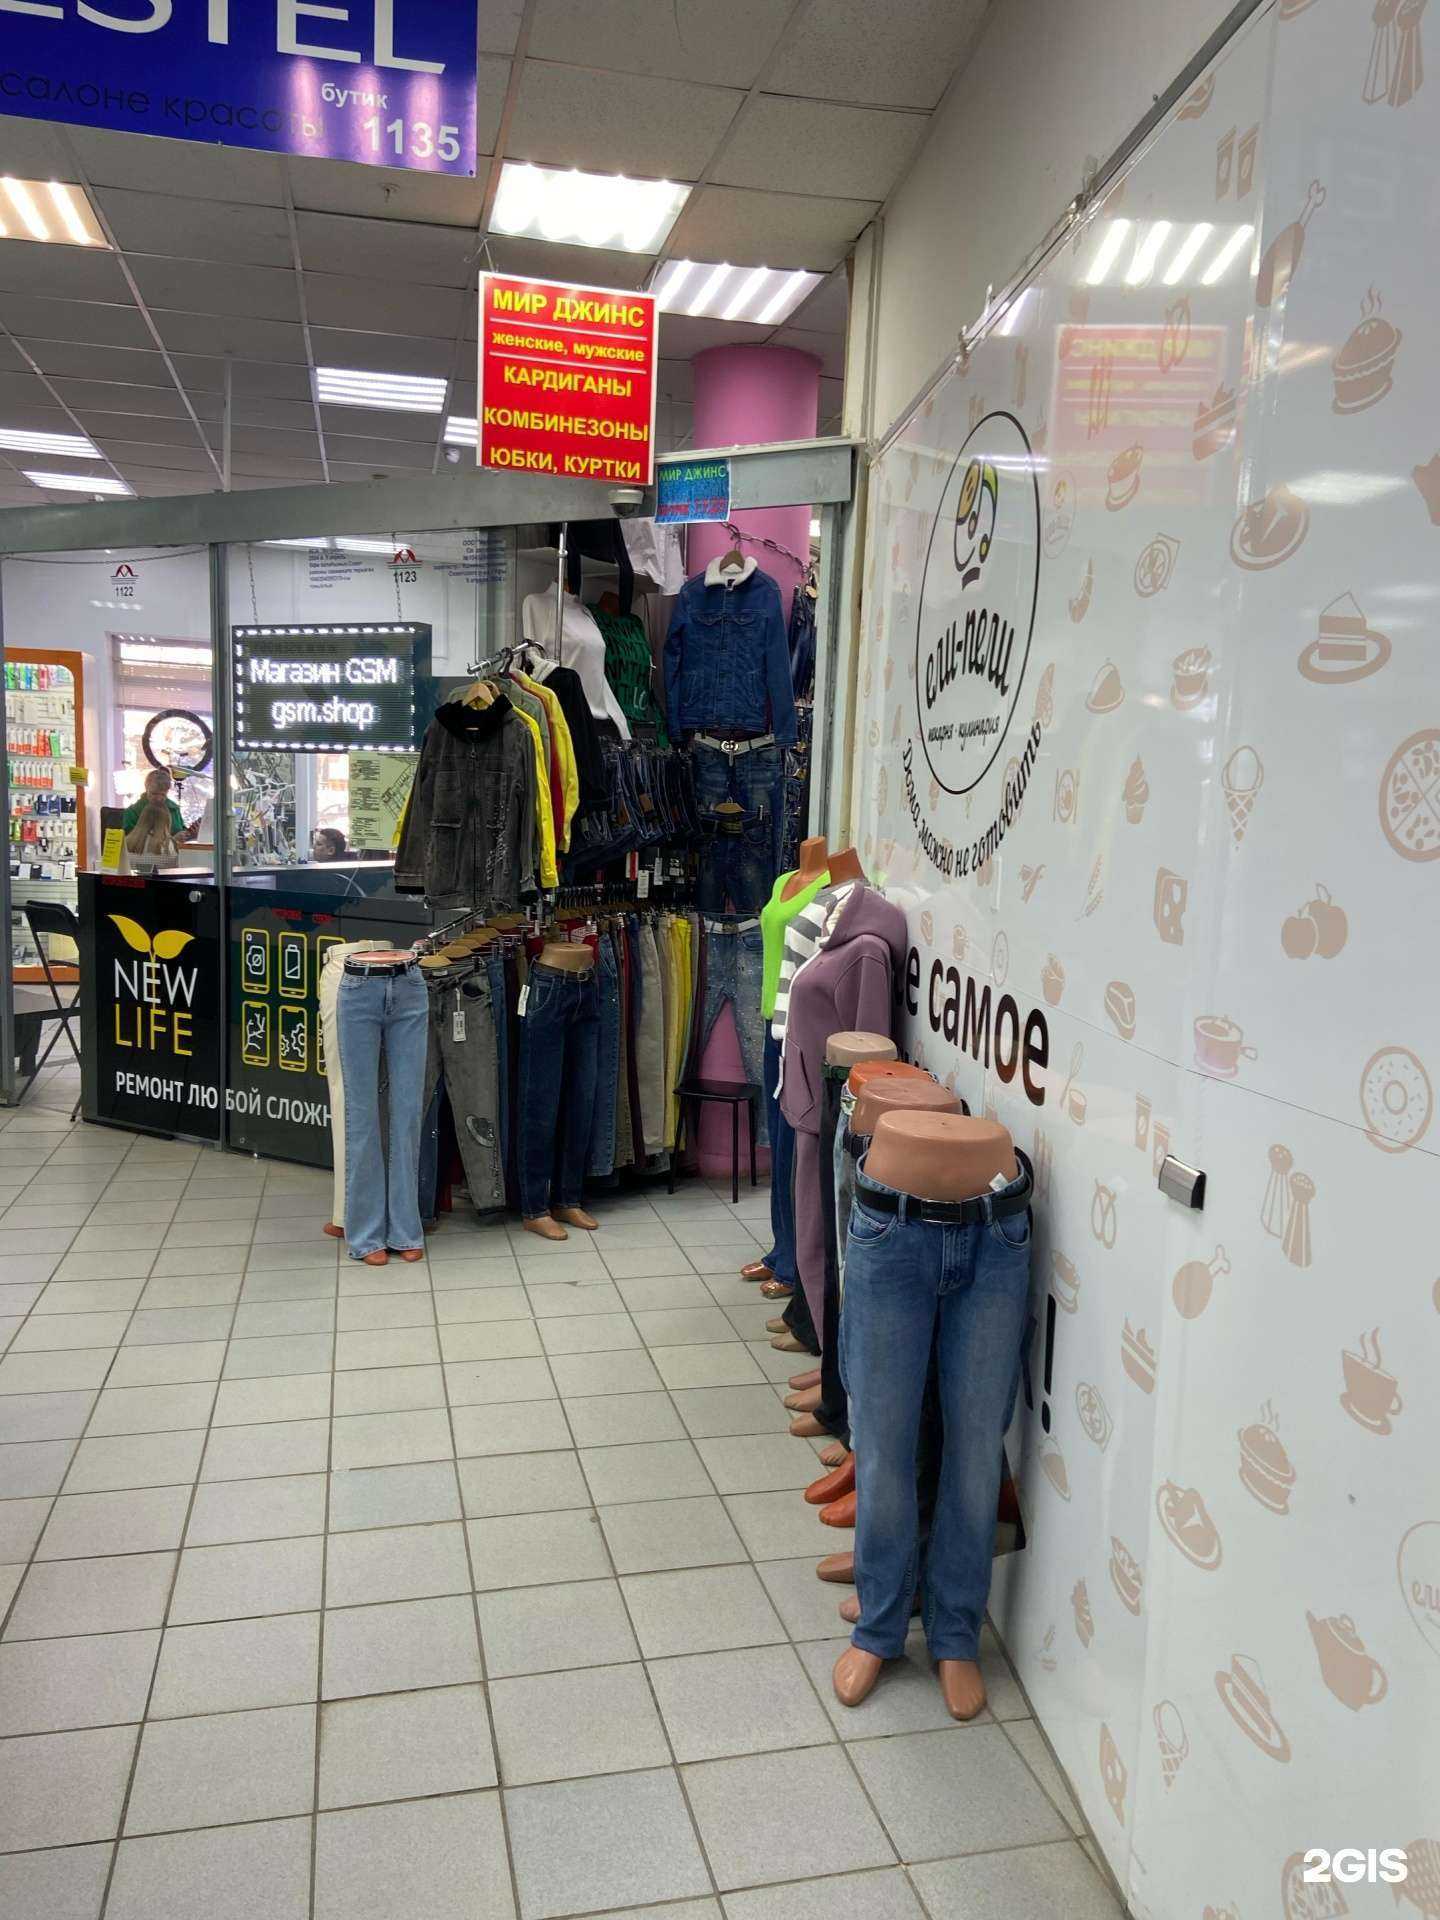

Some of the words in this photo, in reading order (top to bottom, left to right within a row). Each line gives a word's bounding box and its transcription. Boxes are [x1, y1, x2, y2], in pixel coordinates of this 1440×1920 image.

[0, 71, 151, 113] салоне
[164, 96, 324, 138] красоты
[321, 82, 388, 110] бутик
[363, 117, 461, 162] 1135
[493, 288, 548, 315] МИР
[552, 296, 645, 328] ДЖИНС
[492, 331, 568, 355] женские,
[573, 341, 645, 362] мужские
[503, 365, 632, 398] КАРДИГАНЫ
[484, 406, 649, 442] КОМБИНЕЗОНЫ
[490, 446, 558, 474] ЮБКИ,
[564, 455, 641, 480] КУРТКИ
[659, 468, 682, 481] МИР
[684, 465, 727, 481] ДЖИНС
[115, 586, 134, 597] 1122
[394, 570, 417, 583] 1123
[250, 657, 340, 684] Магазин
[345, 657, 398, 684] GSM
[271, 695, 375, 731] gsm.shop
[955, 847, 970, 878] не
[114, 958, 198, 1008] NEW
[115, 1002, 193, 1057] LIFE
[928, 957, 1050, 1107] самое
[115, 1071, 184, 1103] РЕМОНТ
